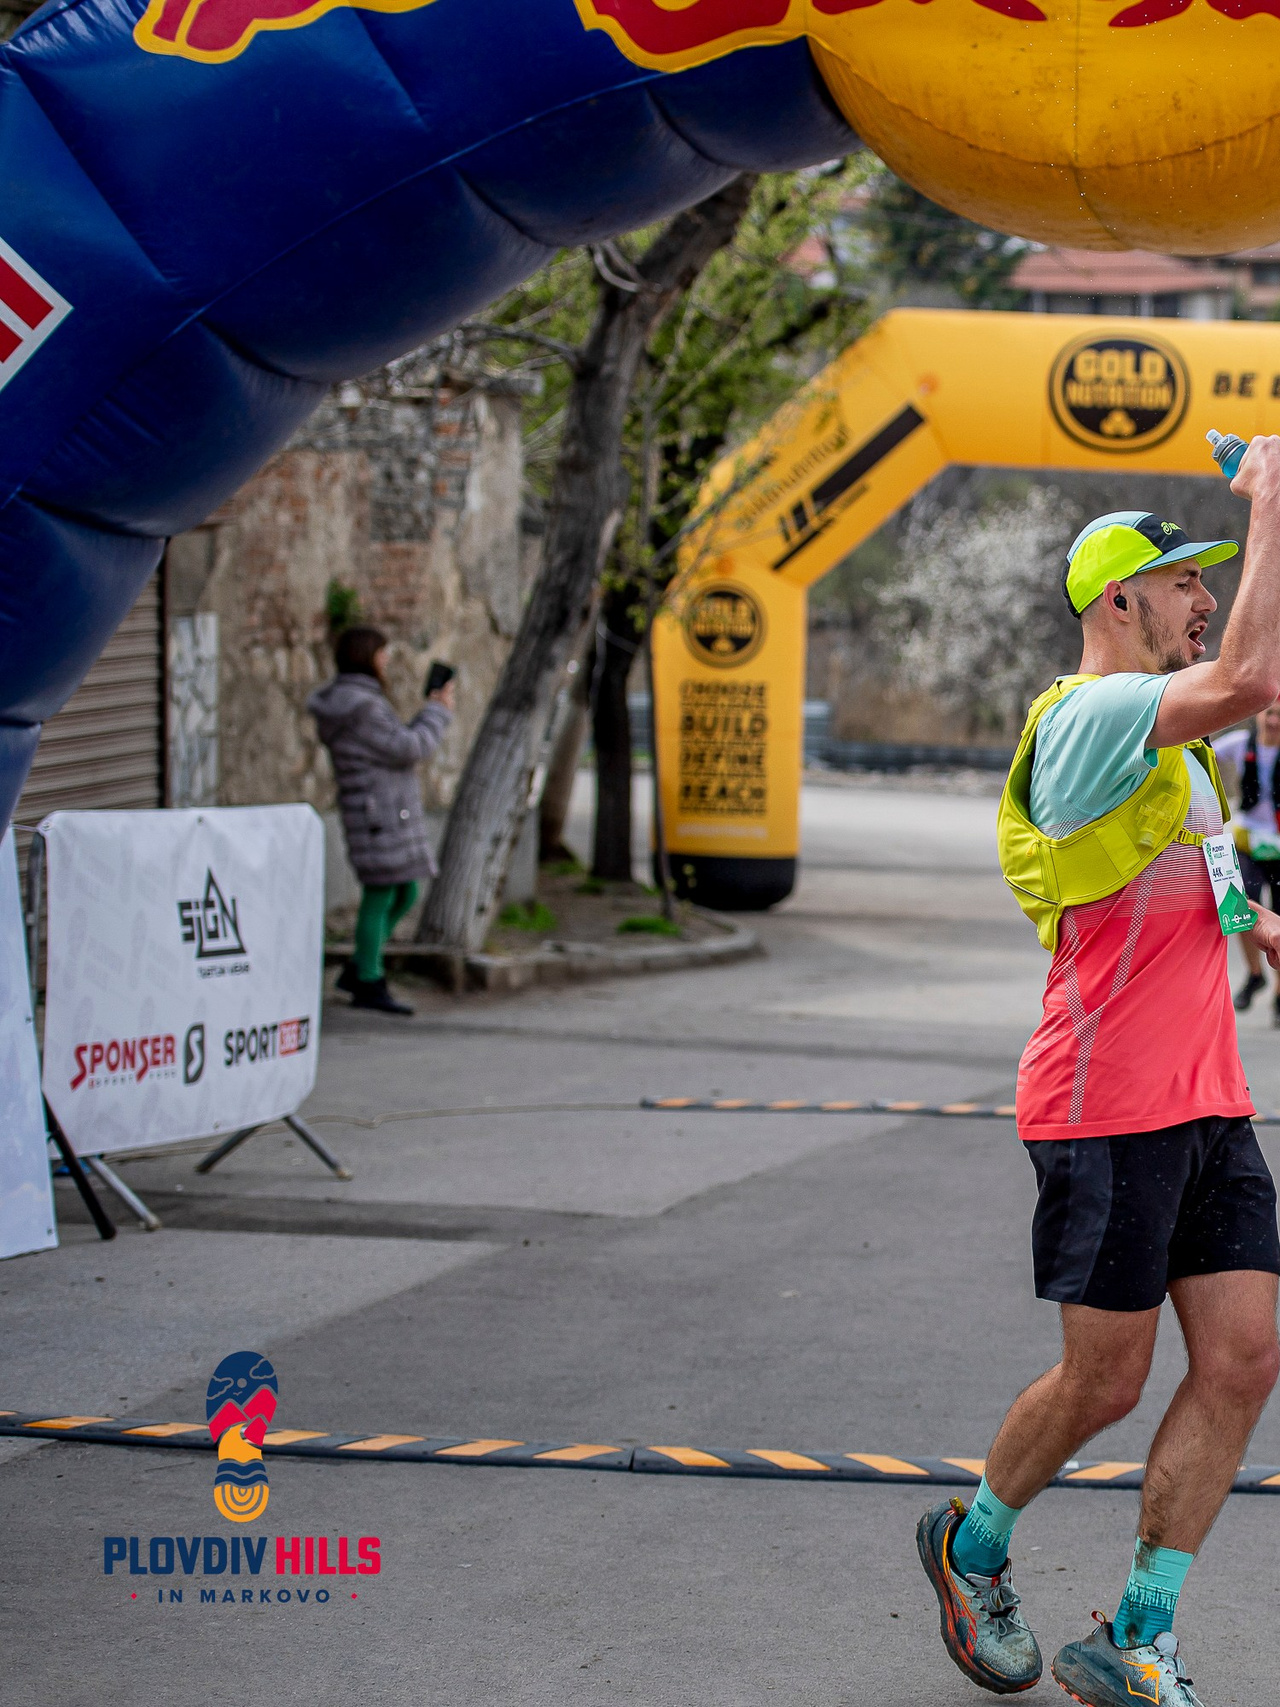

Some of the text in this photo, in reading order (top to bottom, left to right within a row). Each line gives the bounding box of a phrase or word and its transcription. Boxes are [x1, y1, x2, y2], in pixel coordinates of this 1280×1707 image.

[1073, 348, 1167, 381] GOLD
[1212, 371, 1258, 398] BE
[680, 712, 769, 738] BUILD
[70, 1033, 175, 1092] SPONSER
